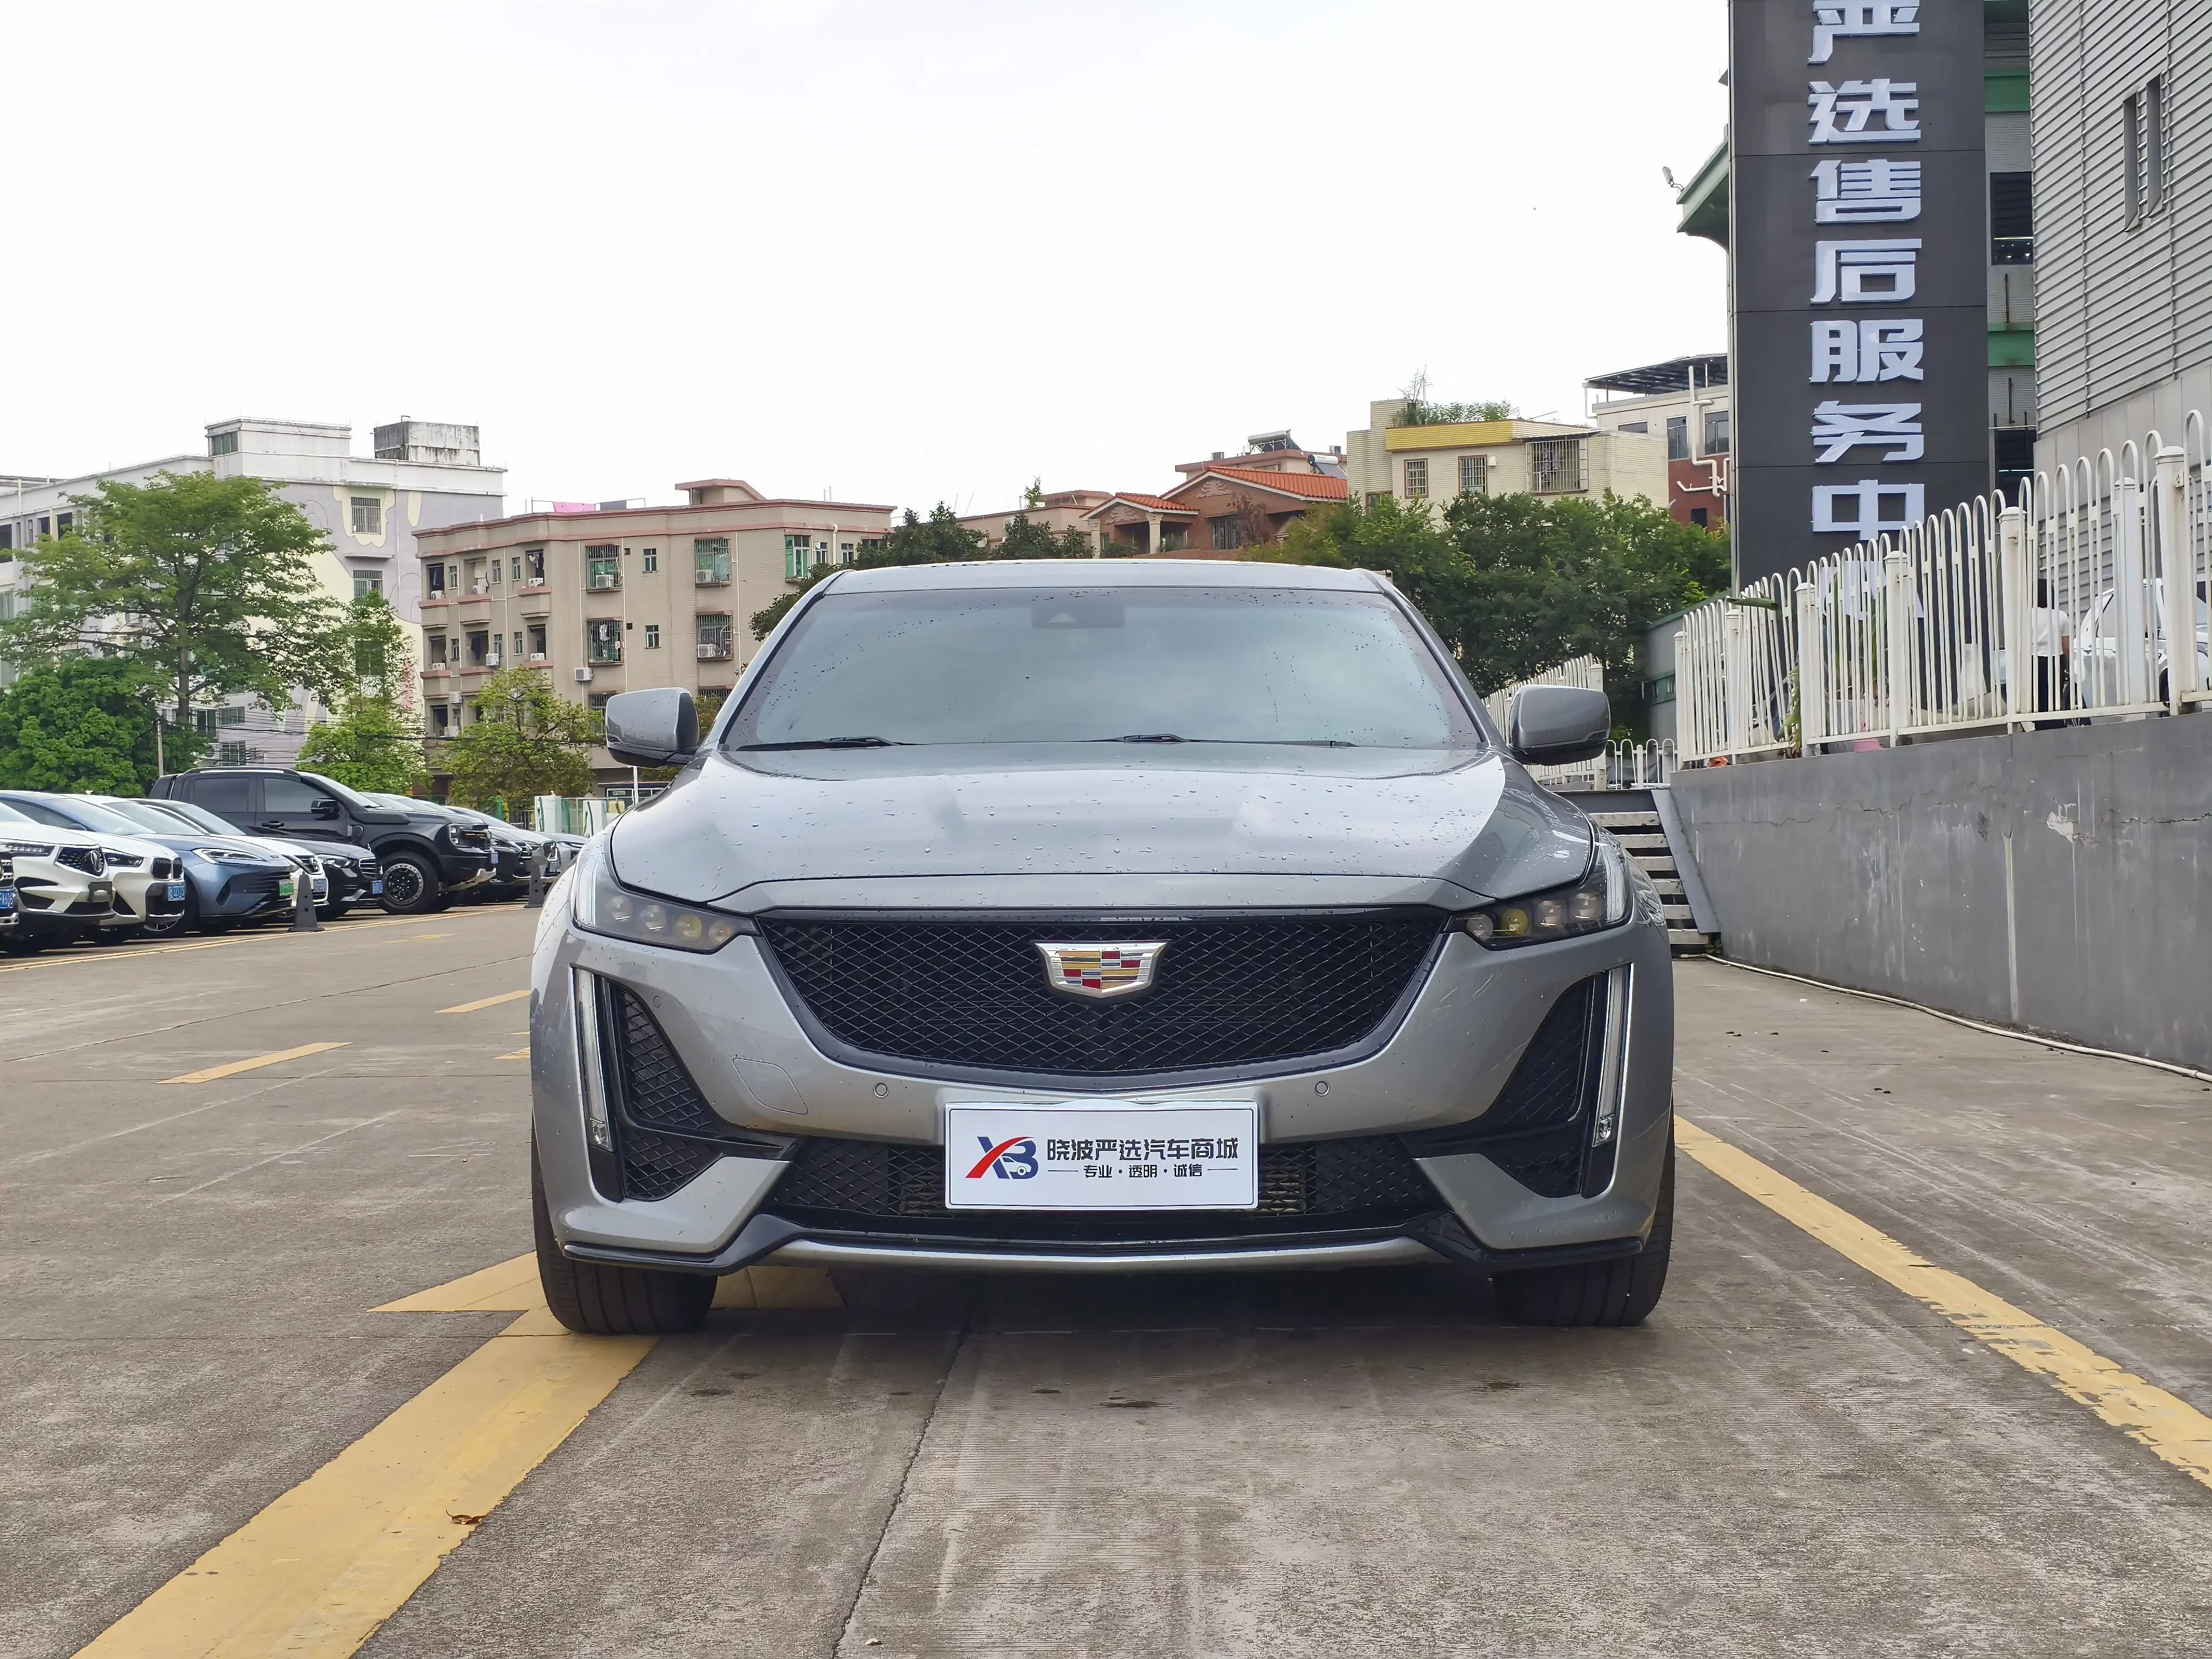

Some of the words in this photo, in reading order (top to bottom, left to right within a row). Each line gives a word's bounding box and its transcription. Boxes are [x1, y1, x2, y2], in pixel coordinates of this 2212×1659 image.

[1047, 1137, 1238, 1161] 晓波严选汽车商城
